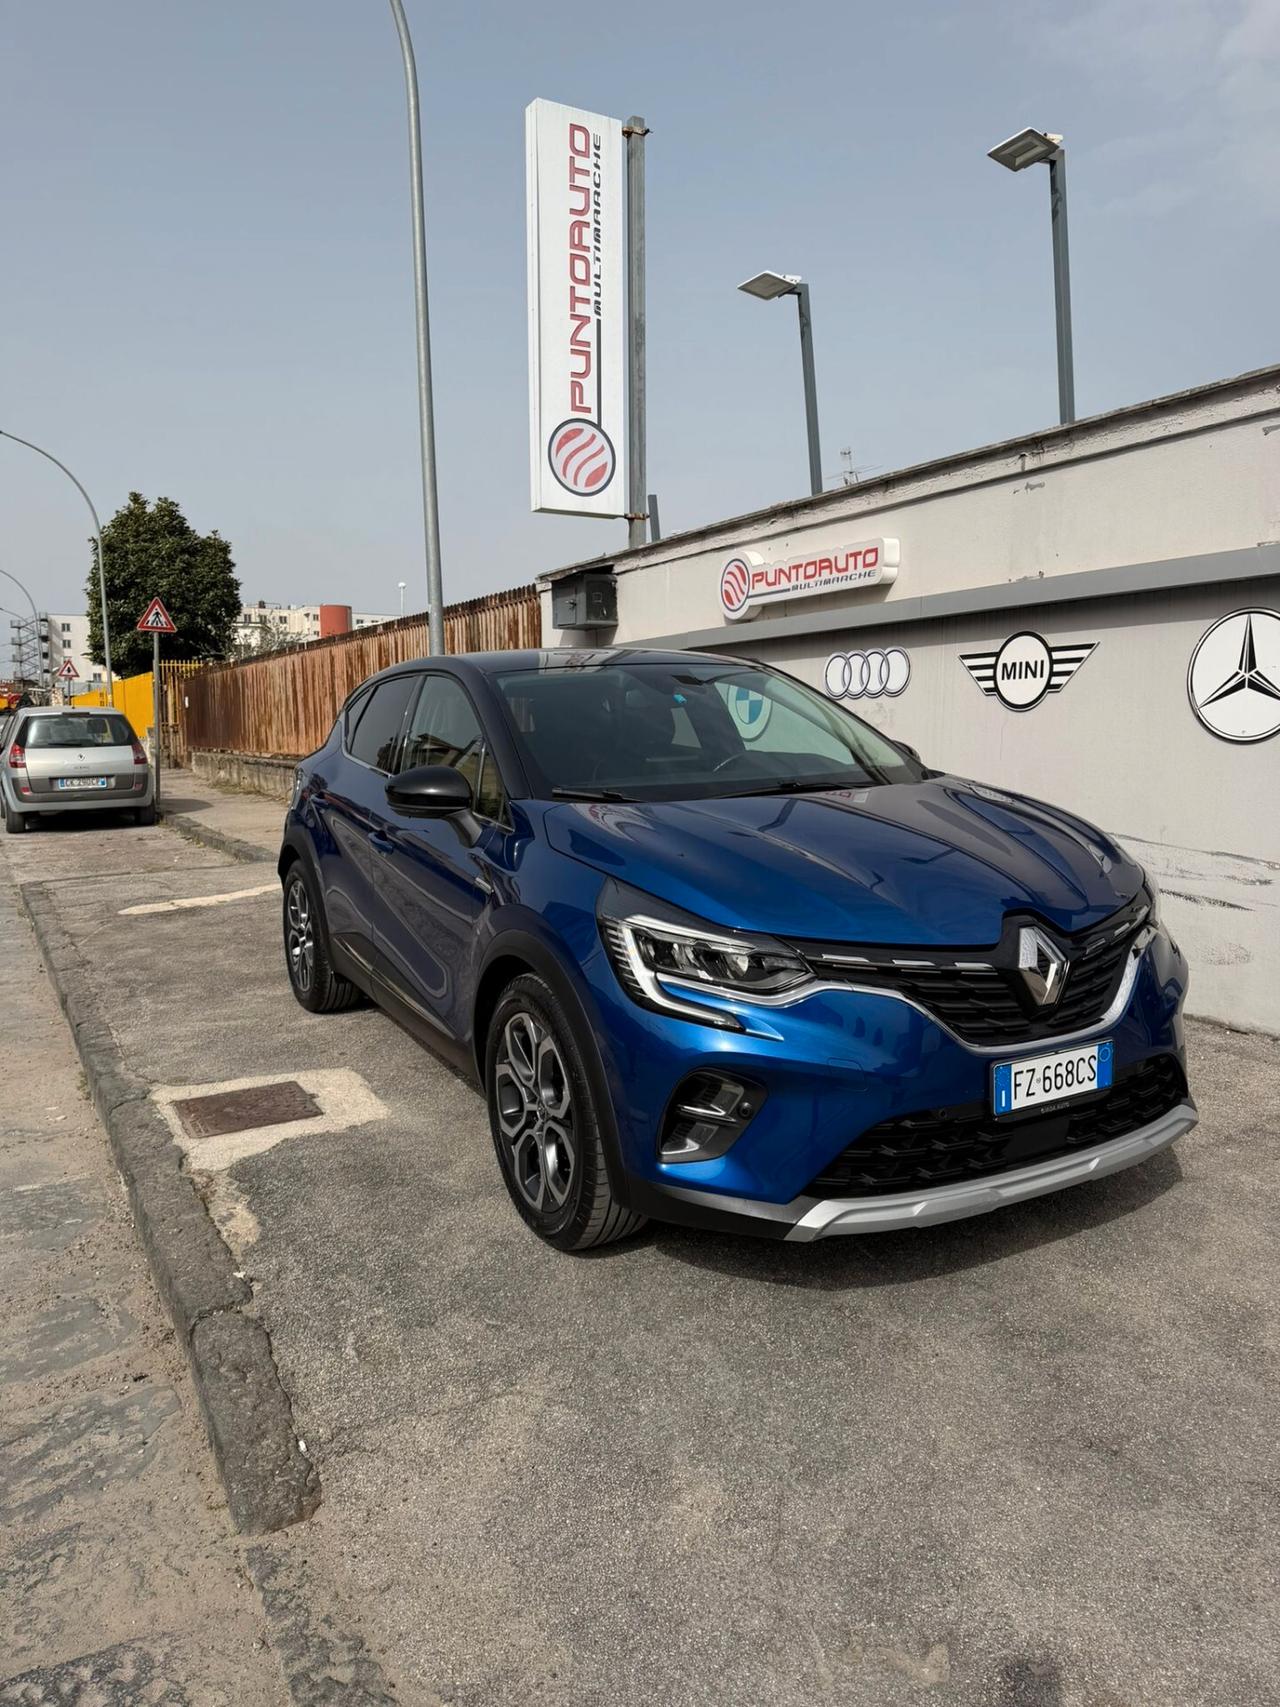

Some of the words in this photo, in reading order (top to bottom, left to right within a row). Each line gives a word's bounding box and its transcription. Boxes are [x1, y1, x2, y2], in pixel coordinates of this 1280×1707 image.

[593, 133, 602, 316] MULTIMARCHE
[569, 123, 591, 414] PUNTOAUTO
[751, 547, 879, 590] PUNTOAUTO
[791, 570, 877, 591] MULTIMARCHE
[1001, 660, 1044, 681] MINI
